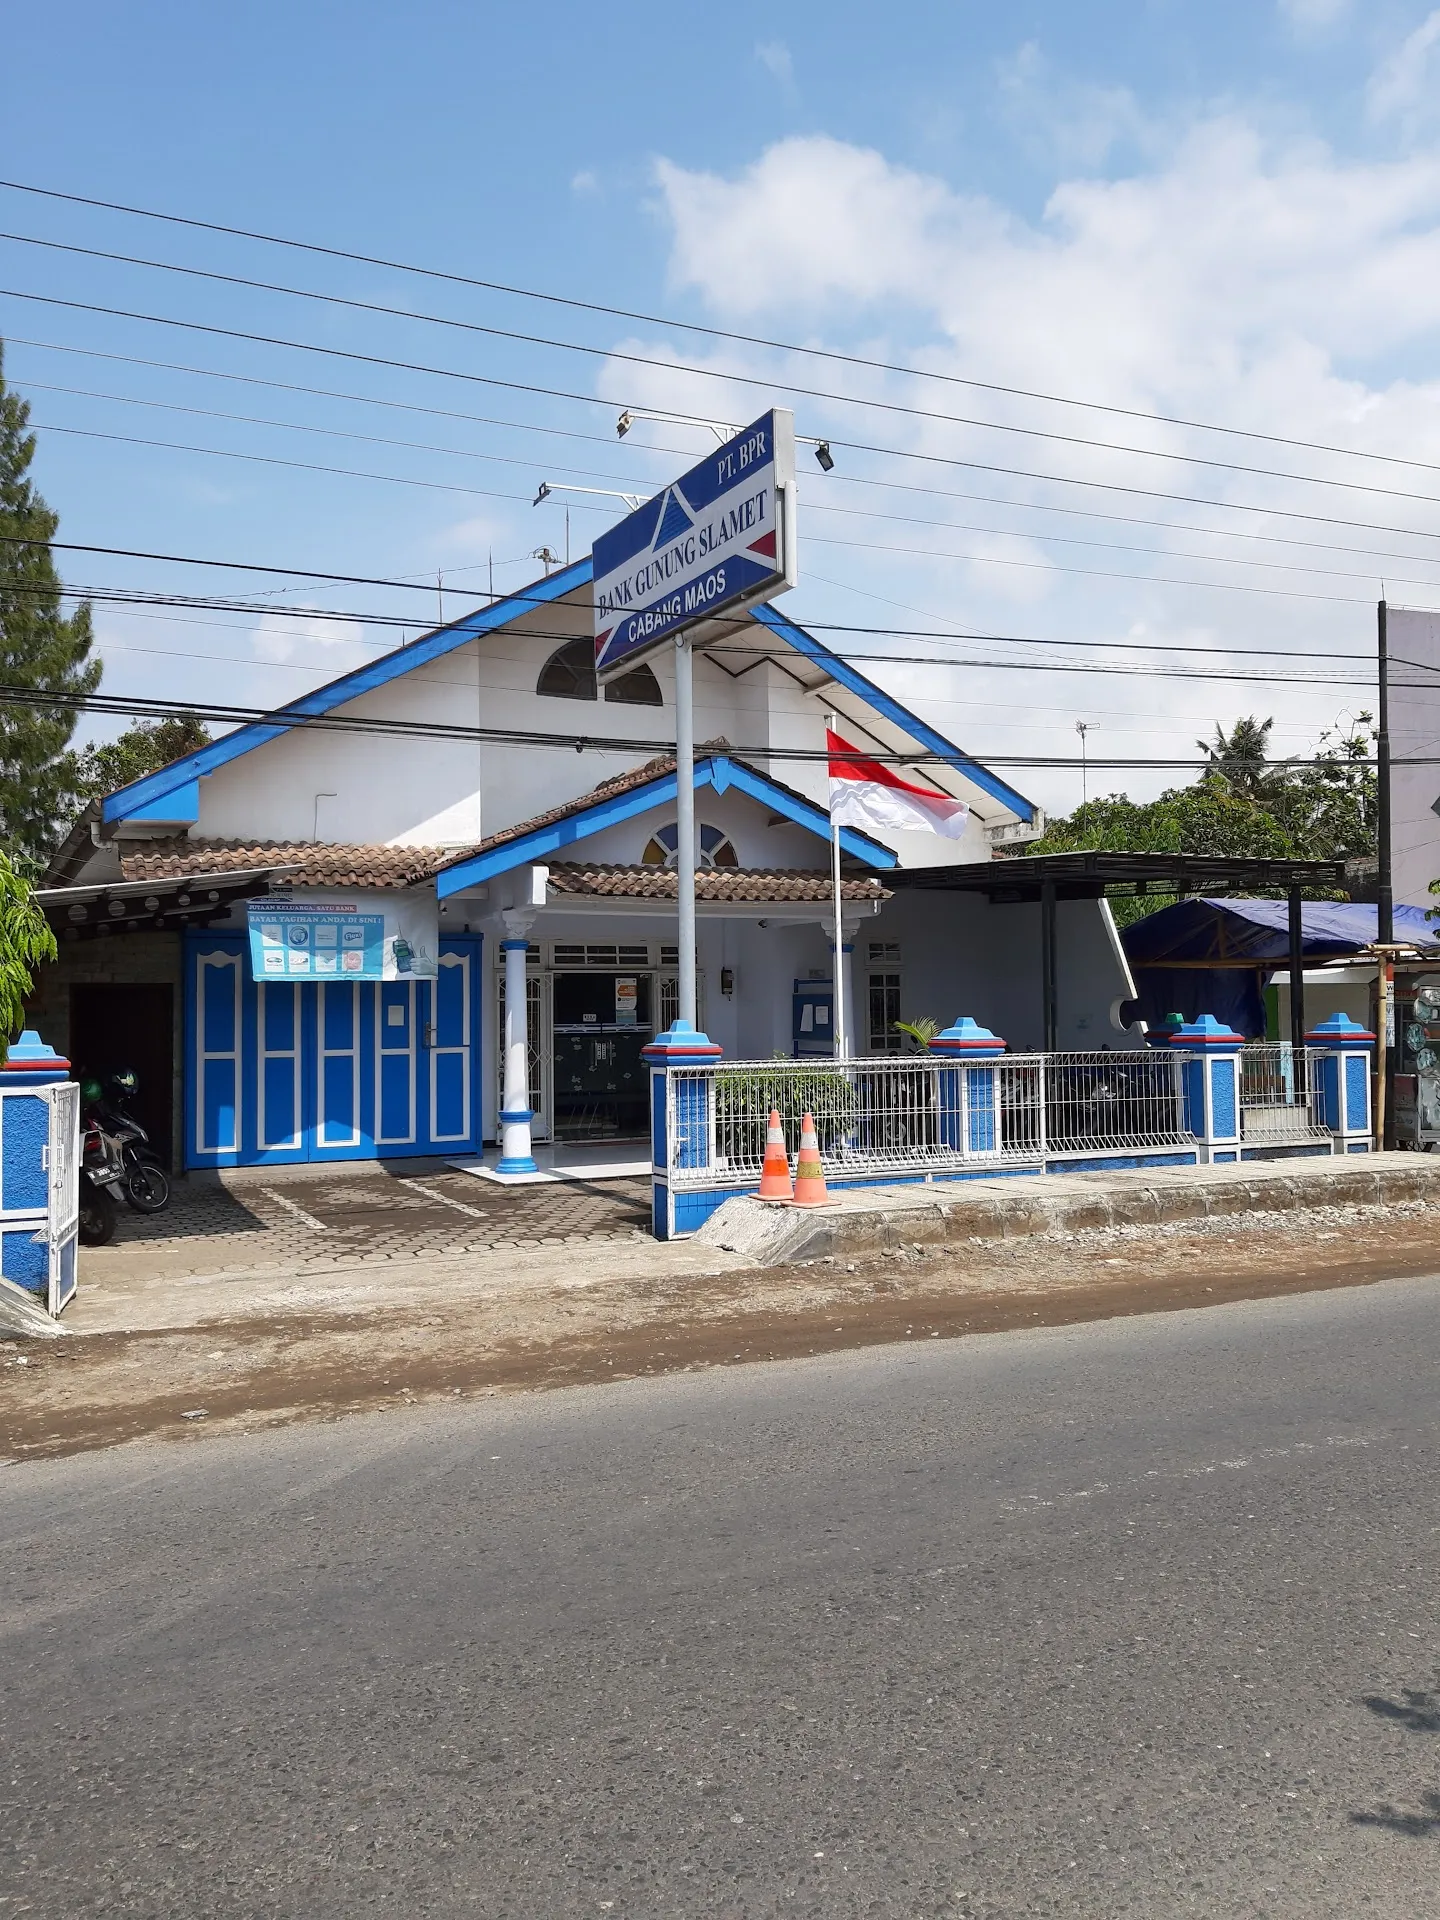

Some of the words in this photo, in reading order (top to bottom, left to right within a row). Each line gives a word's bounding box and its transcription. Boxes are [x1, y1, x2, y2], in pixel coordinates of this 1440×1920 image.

[717, 453, 736, 485] PT.
[739, 431, 766, 470] BPR
[599, 577, 633, 620] BANK
[635, 537, 695, 597] GUNUNG
[699, 489, 767, 559] SLAMET
[628, 595, 681, 643] CABANG
[685, 568, 726, 613] MAOS
[249, 915, 277, 923] BAYAR
